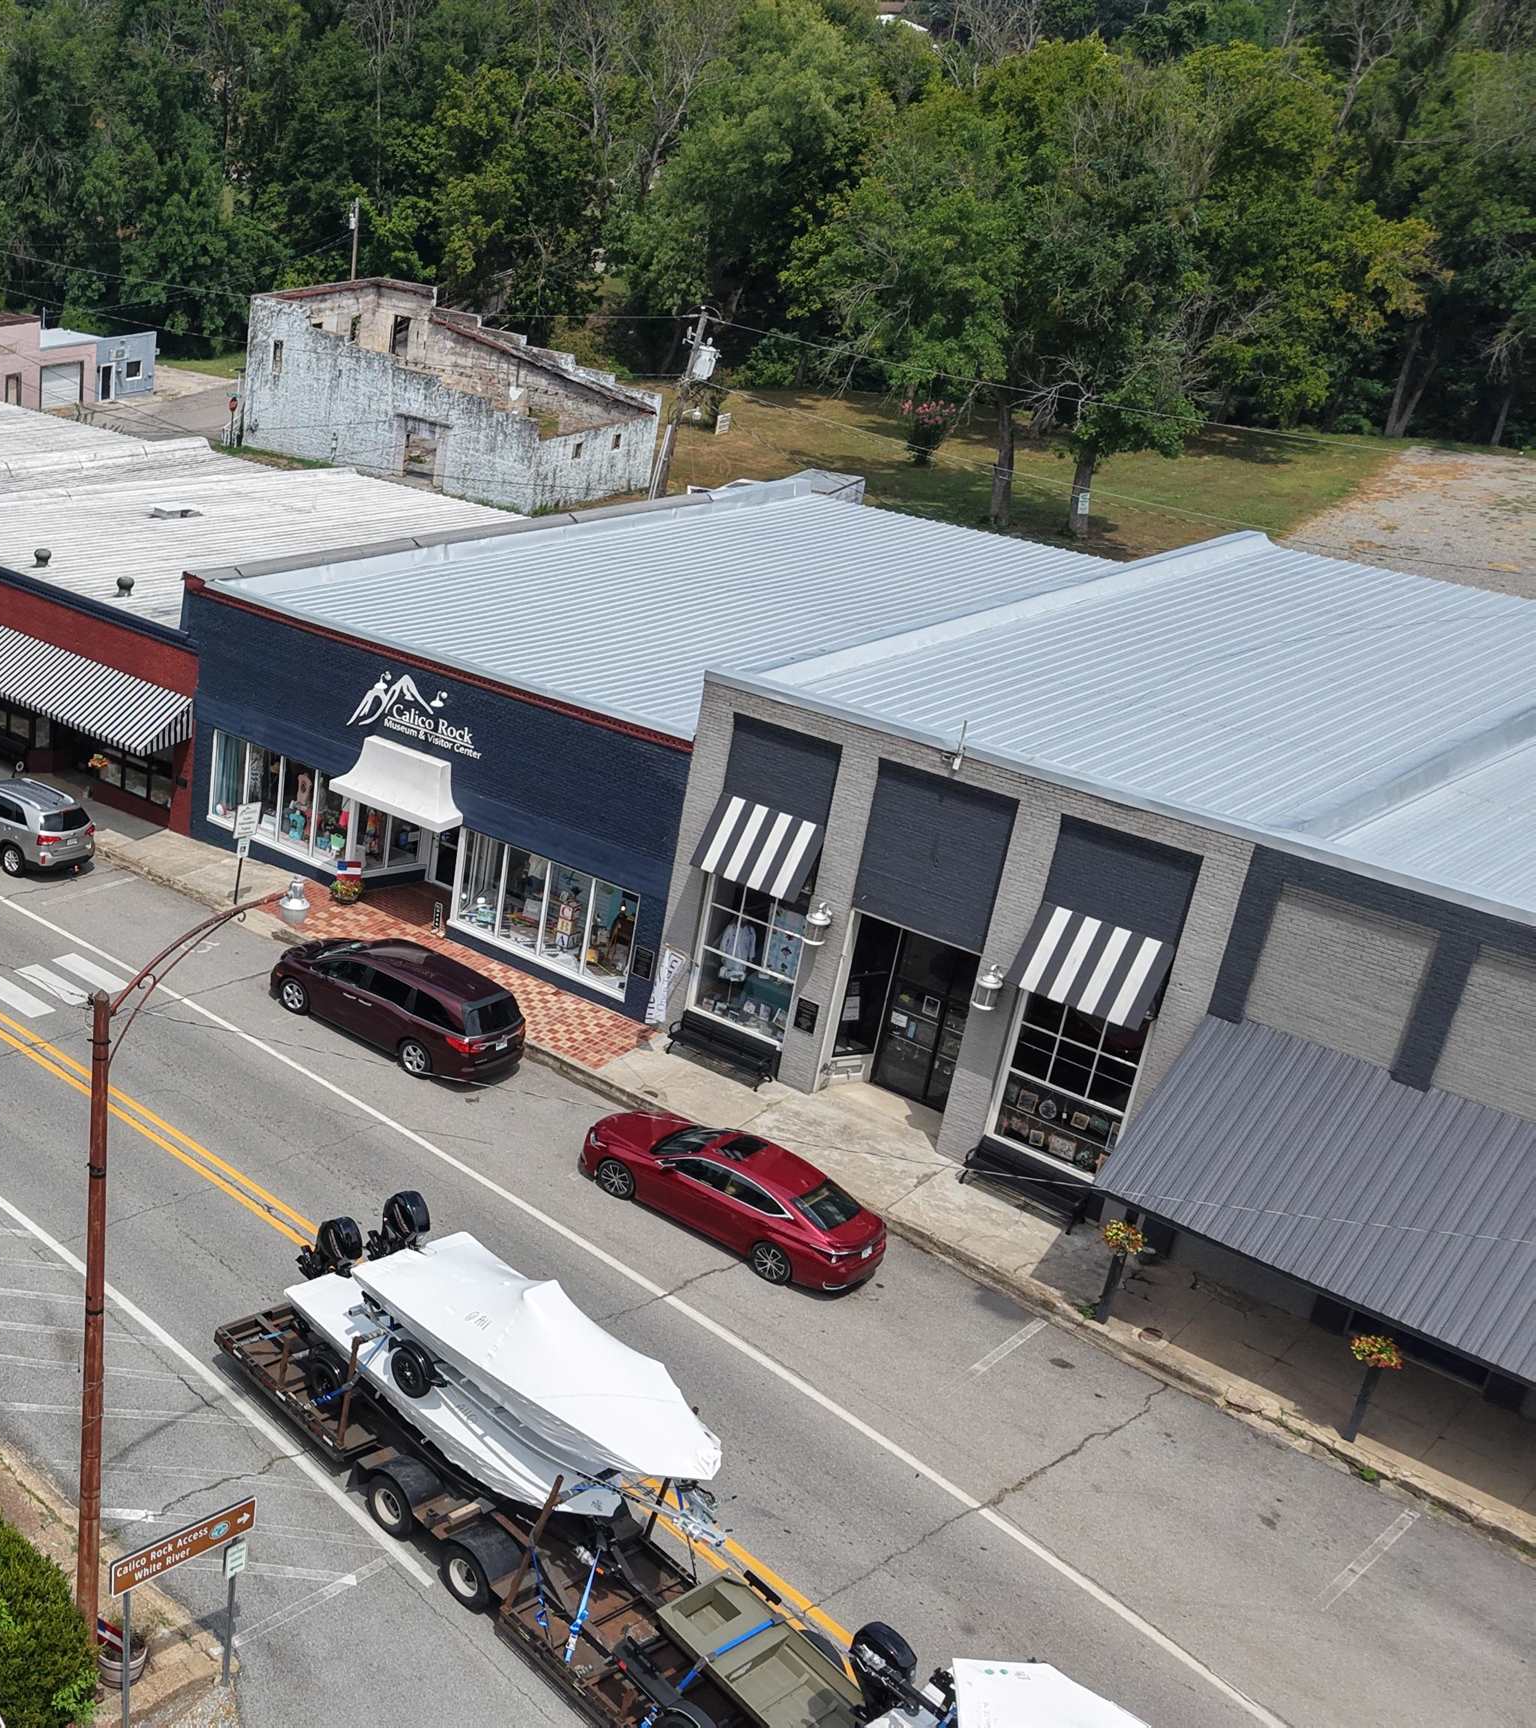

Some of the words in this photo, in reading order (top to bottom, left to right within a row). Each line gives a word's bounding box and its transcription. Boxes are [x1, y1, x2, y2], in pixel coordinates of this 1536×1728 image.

[383, 717, 418, 738] Museum
[418, 729, 427, 741] &
[427, 733, 454, 751] Visitor
[453, 743, 482, 760] Center
[392, 704, 434, 730] Calico
[438, 718, 473, 745] Rock
[116, 1556, 147, 1578] Calico
[150, 1543, 174, 1561] Rock
[176, 1526, 209, 1547] Access
[134, 1560, 163, 1581] White
[166, 1547, 191, 1565] River
